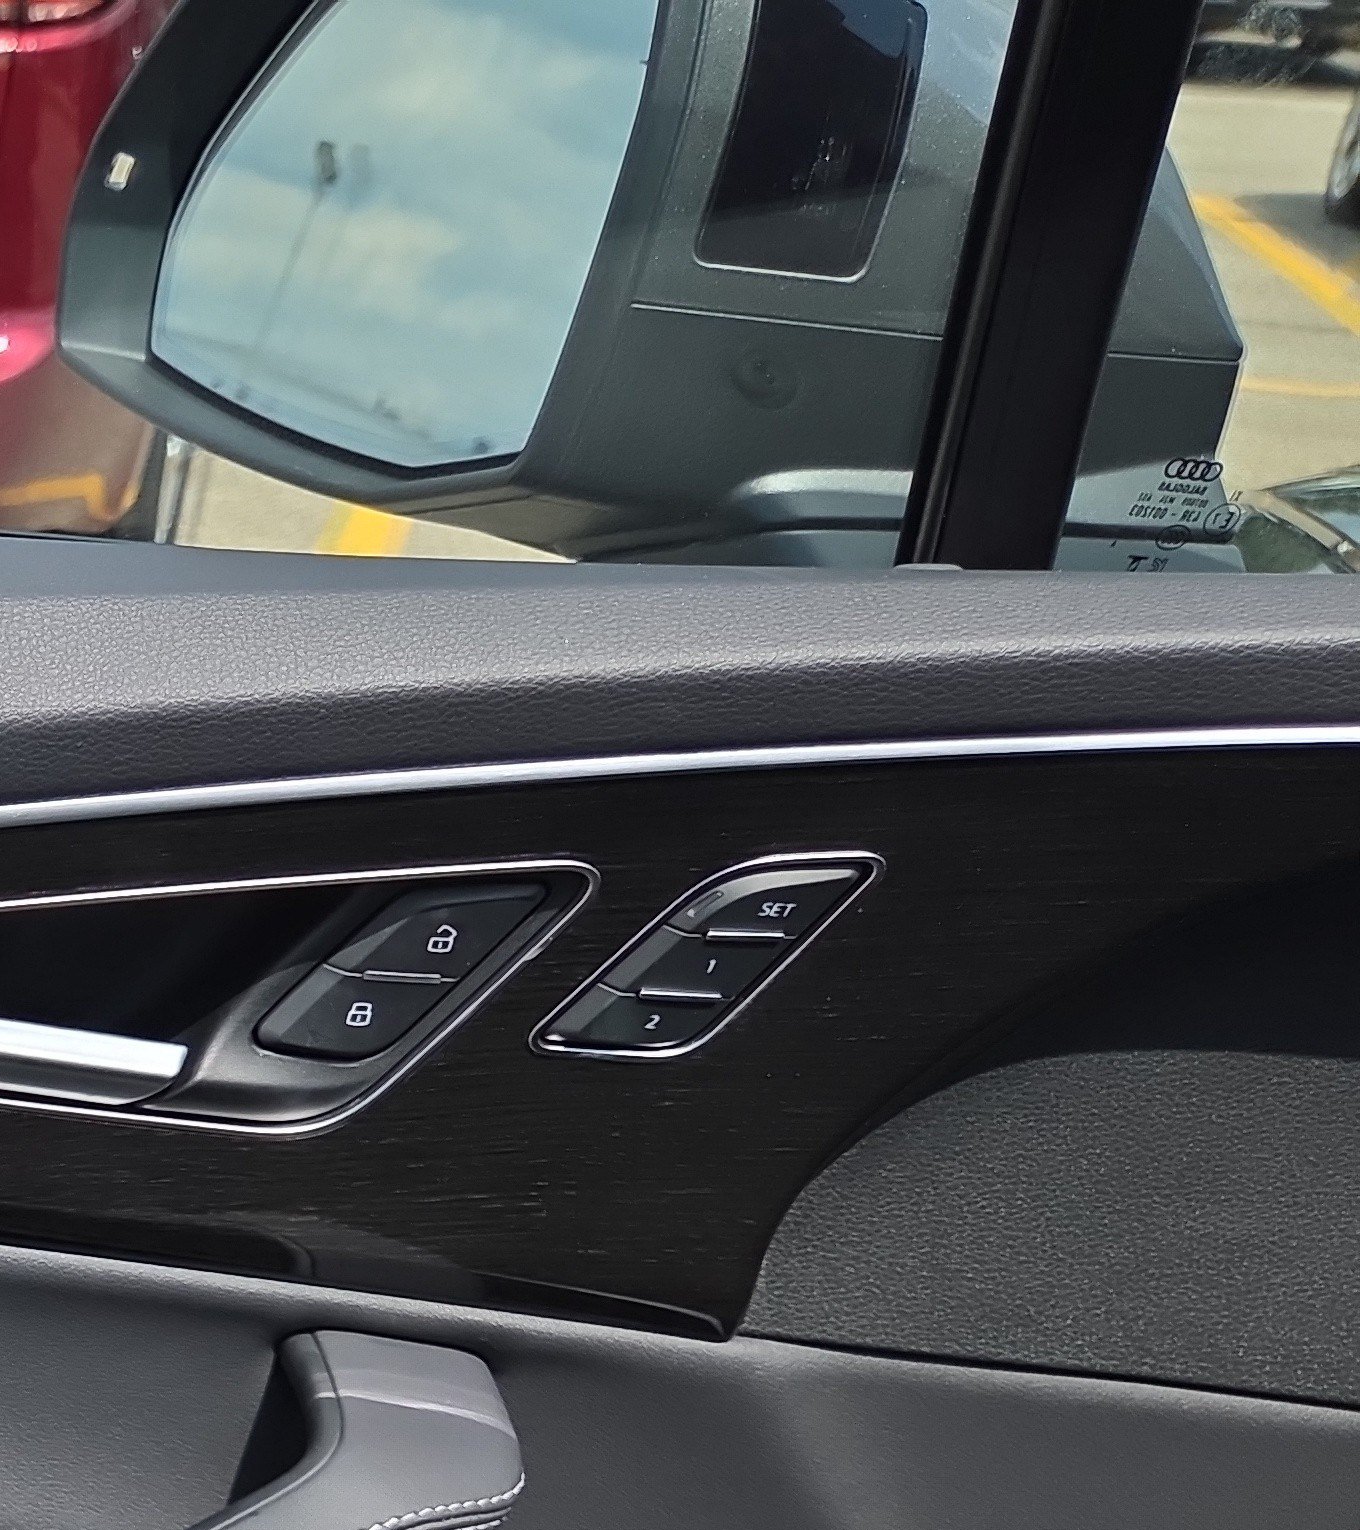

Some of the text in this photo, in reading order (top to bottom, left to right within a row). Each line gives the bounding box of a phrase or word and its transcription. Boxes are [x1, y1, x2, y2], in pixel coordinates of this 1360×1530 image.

[757, 902, 797, 918] SET
[707, 959, 717, 974] 1
[644, 1014, 661, 1030] 2
